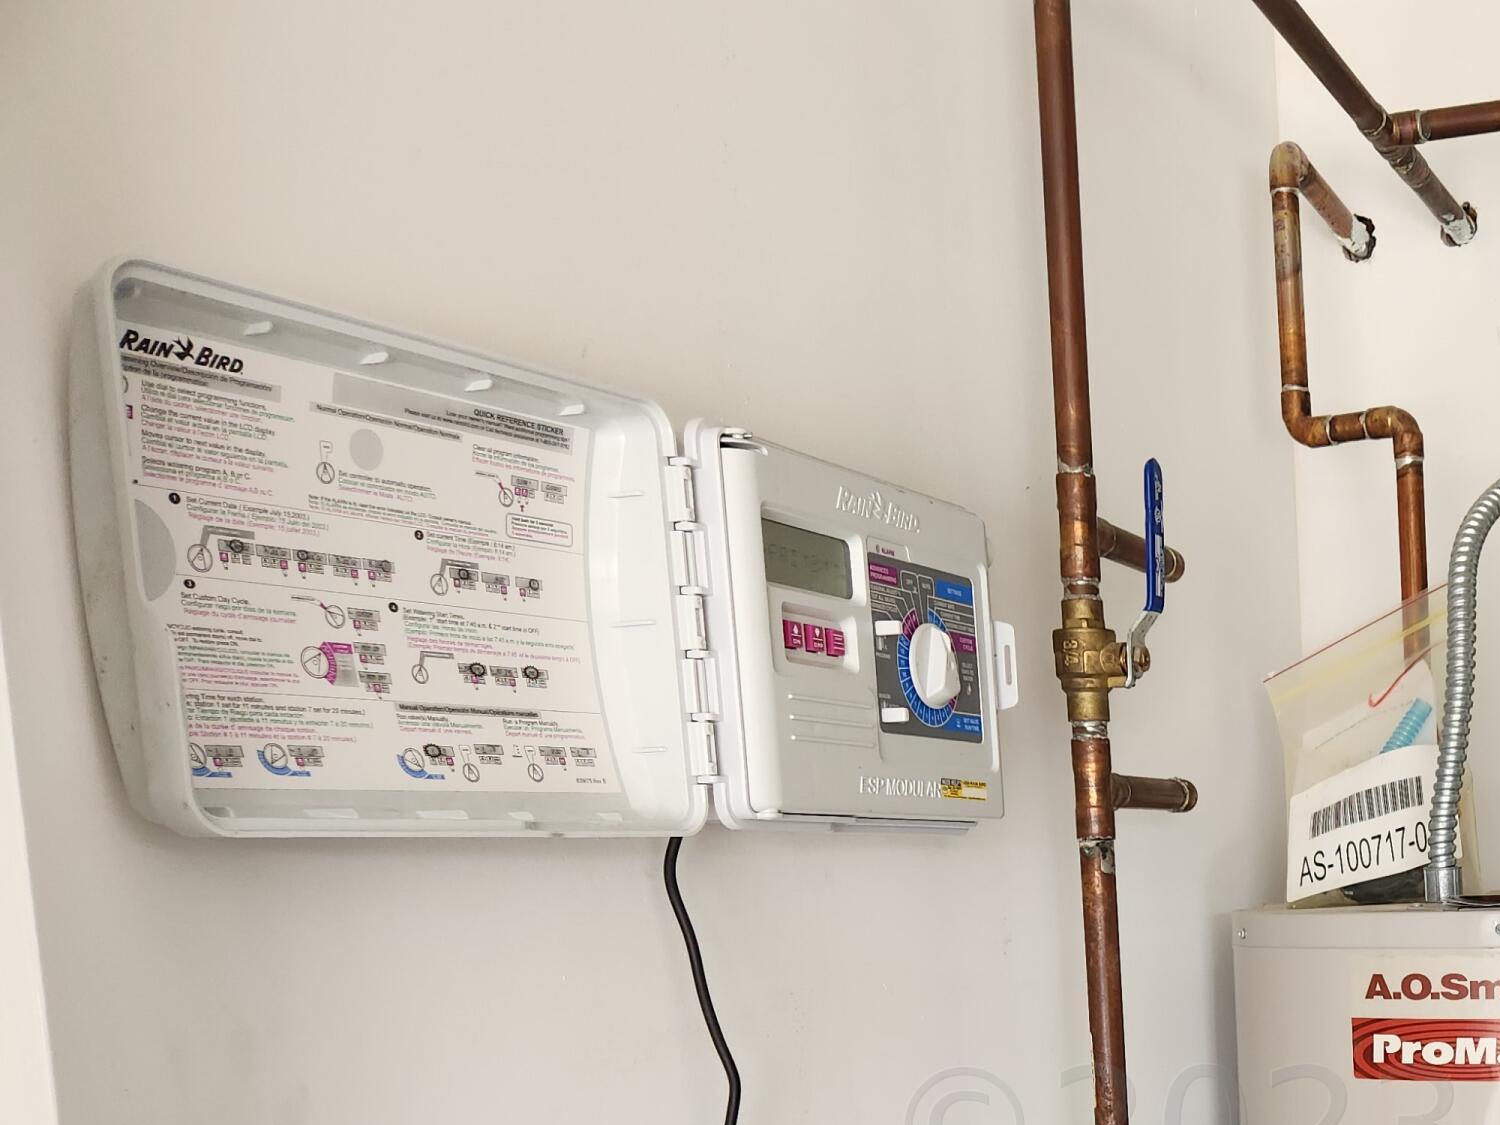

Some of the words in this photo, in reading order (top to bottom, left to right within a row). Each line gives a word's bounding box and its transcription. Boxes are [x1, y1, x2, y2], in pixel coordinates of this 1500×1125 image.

[119, 329, 174, 358] RAIN
[195, 347, 243, 373] BIRD
[142, 379, 154, 389] Use
[177, 386, 196, 398] select
[197, 390, 238, 408] programming
[141, 404, 168, 417] Change
[168, 409, 179, 418] the
[180, 411, 202, 421] current
[203, 415, 220, 425] value
[221, 418, 228, 426] in
[228, 419, 238, 428] the
[239, 421, 253, 431] LCD
[473, 408, 495, 421] QUICK
[496, 412, 536, 430] REFERENCE
[536, 420, 564, 436] STICKER
[141, 429, 163, 440] Moves
[164, 433, 185, 443] cursor
[193, 439, 207, 448] next
[208, 441, 225, 450] value
[233, 445, 243, 453] the
[167, 461, 193, 473] watering
[195, 465, 221, 477] program
[186, 495, 199, 504] Set
[199, 497, 222, 508] Current
[222, 501, 238, 510] Date
[836, 486, 869, 518] RAIN
[181, 592, 193, 600] Set
[193, 593, 217, 603] Custom
[218, 596, 230, 606] Day
[403, 607, 412, 615] Set
[200, 693, 217, 701] Time
[226, 695, 242, 703] each
[231, 703, 241, 711] for
[250, 704, 274, 712] minutes
[313, 706, 322, 714] set
[518, 719, 538, 728] Program
[1300, 821, 1427, 887] AS-100717-0
